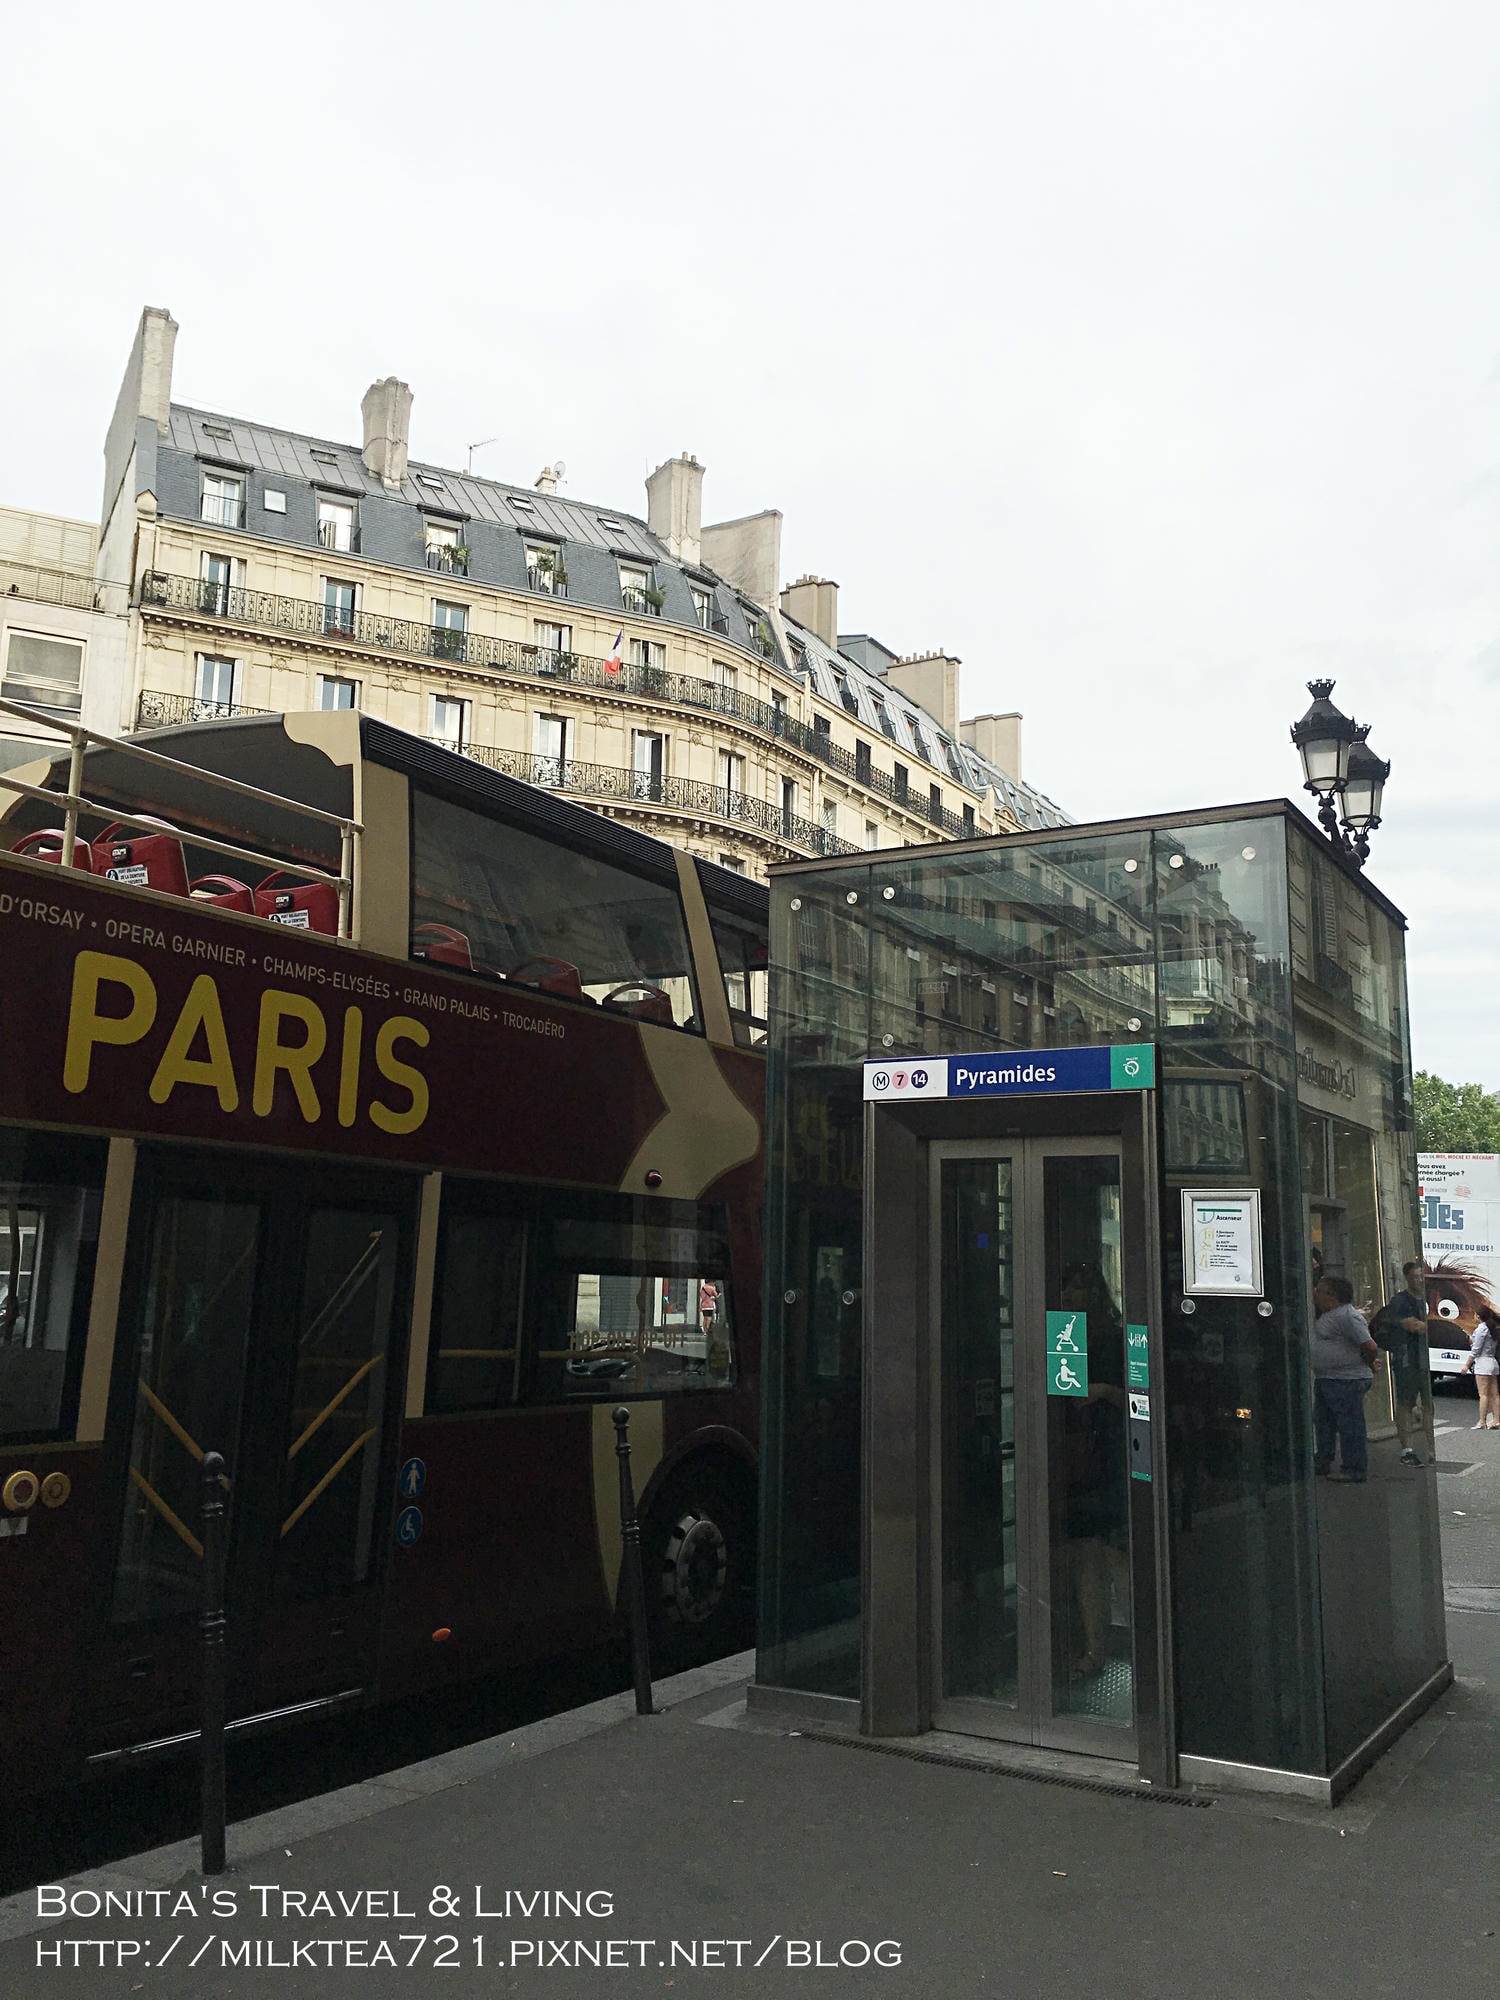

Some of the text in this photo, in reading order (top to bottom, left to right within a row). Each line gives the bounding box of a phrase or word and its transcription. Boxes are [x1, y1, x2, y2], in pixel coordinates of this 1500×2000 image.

[0, 894, 566, 1039] D'ORSAY OPERA GARNIER CHAMPS-ELYSÉES GRAND PALAIS TROCADÉRO
[63, 950, 430, 1135] PARIS
[896, 1074, 905, 1086] 7
[912, 1072, 926, 1085] 14
[956, 1065, 1056, 1089] Pyramides
